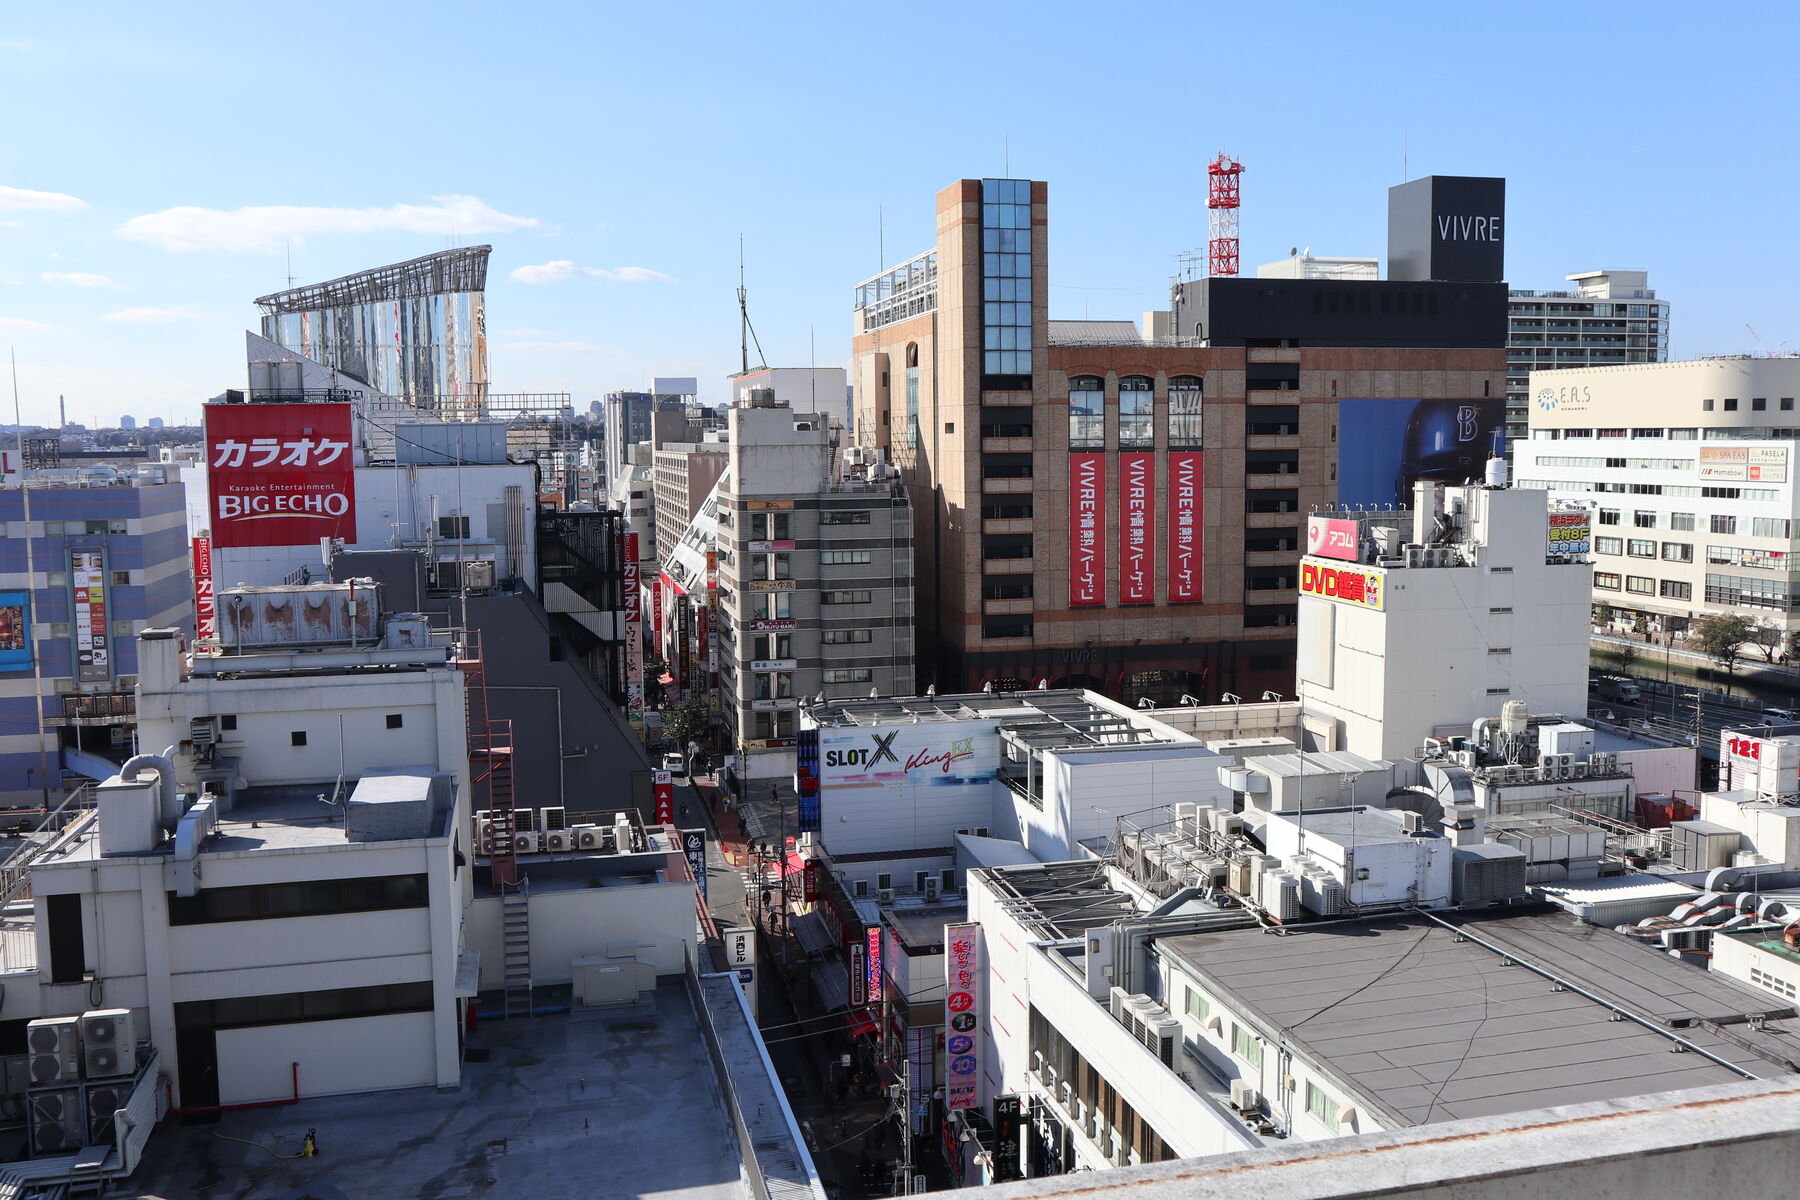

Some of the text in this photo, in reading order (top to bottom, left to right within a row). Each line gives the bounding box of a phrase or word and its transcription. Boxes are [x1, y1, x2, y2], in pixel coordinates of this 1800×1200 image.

[1437, 214, 1501, 243] VIVRE
[212, 437, 350, 469] カラオケ
[1719, 451, 1731, 460] SPA
[1732, 451, 1746, 460] EAS
[1760, 450, 1786, 458] PASELA
[229, 483, 336, 492] Karaoke Entertainment
[218, 492, 350, 520] BIG ECHO
[1328, 529, 1355, 549] アコム
[1548, 528, 1591, 541] 受付8F
[199, 538, 209, 575] BIG ECHO
[1548, 541, 1591, 554] 年中無休
[624, 563, 640, 623] カラオケ
[1302, 563, 1366, 604] DVD鑑賞
[1061, 650, 1097, 664] VIVRE
[826, 729, 899, 772] SLOT X
[903, 748, 974, 773] King
[657, 774, 669, 782] 6F
[997, 1100, 1018, 1113] 4F
